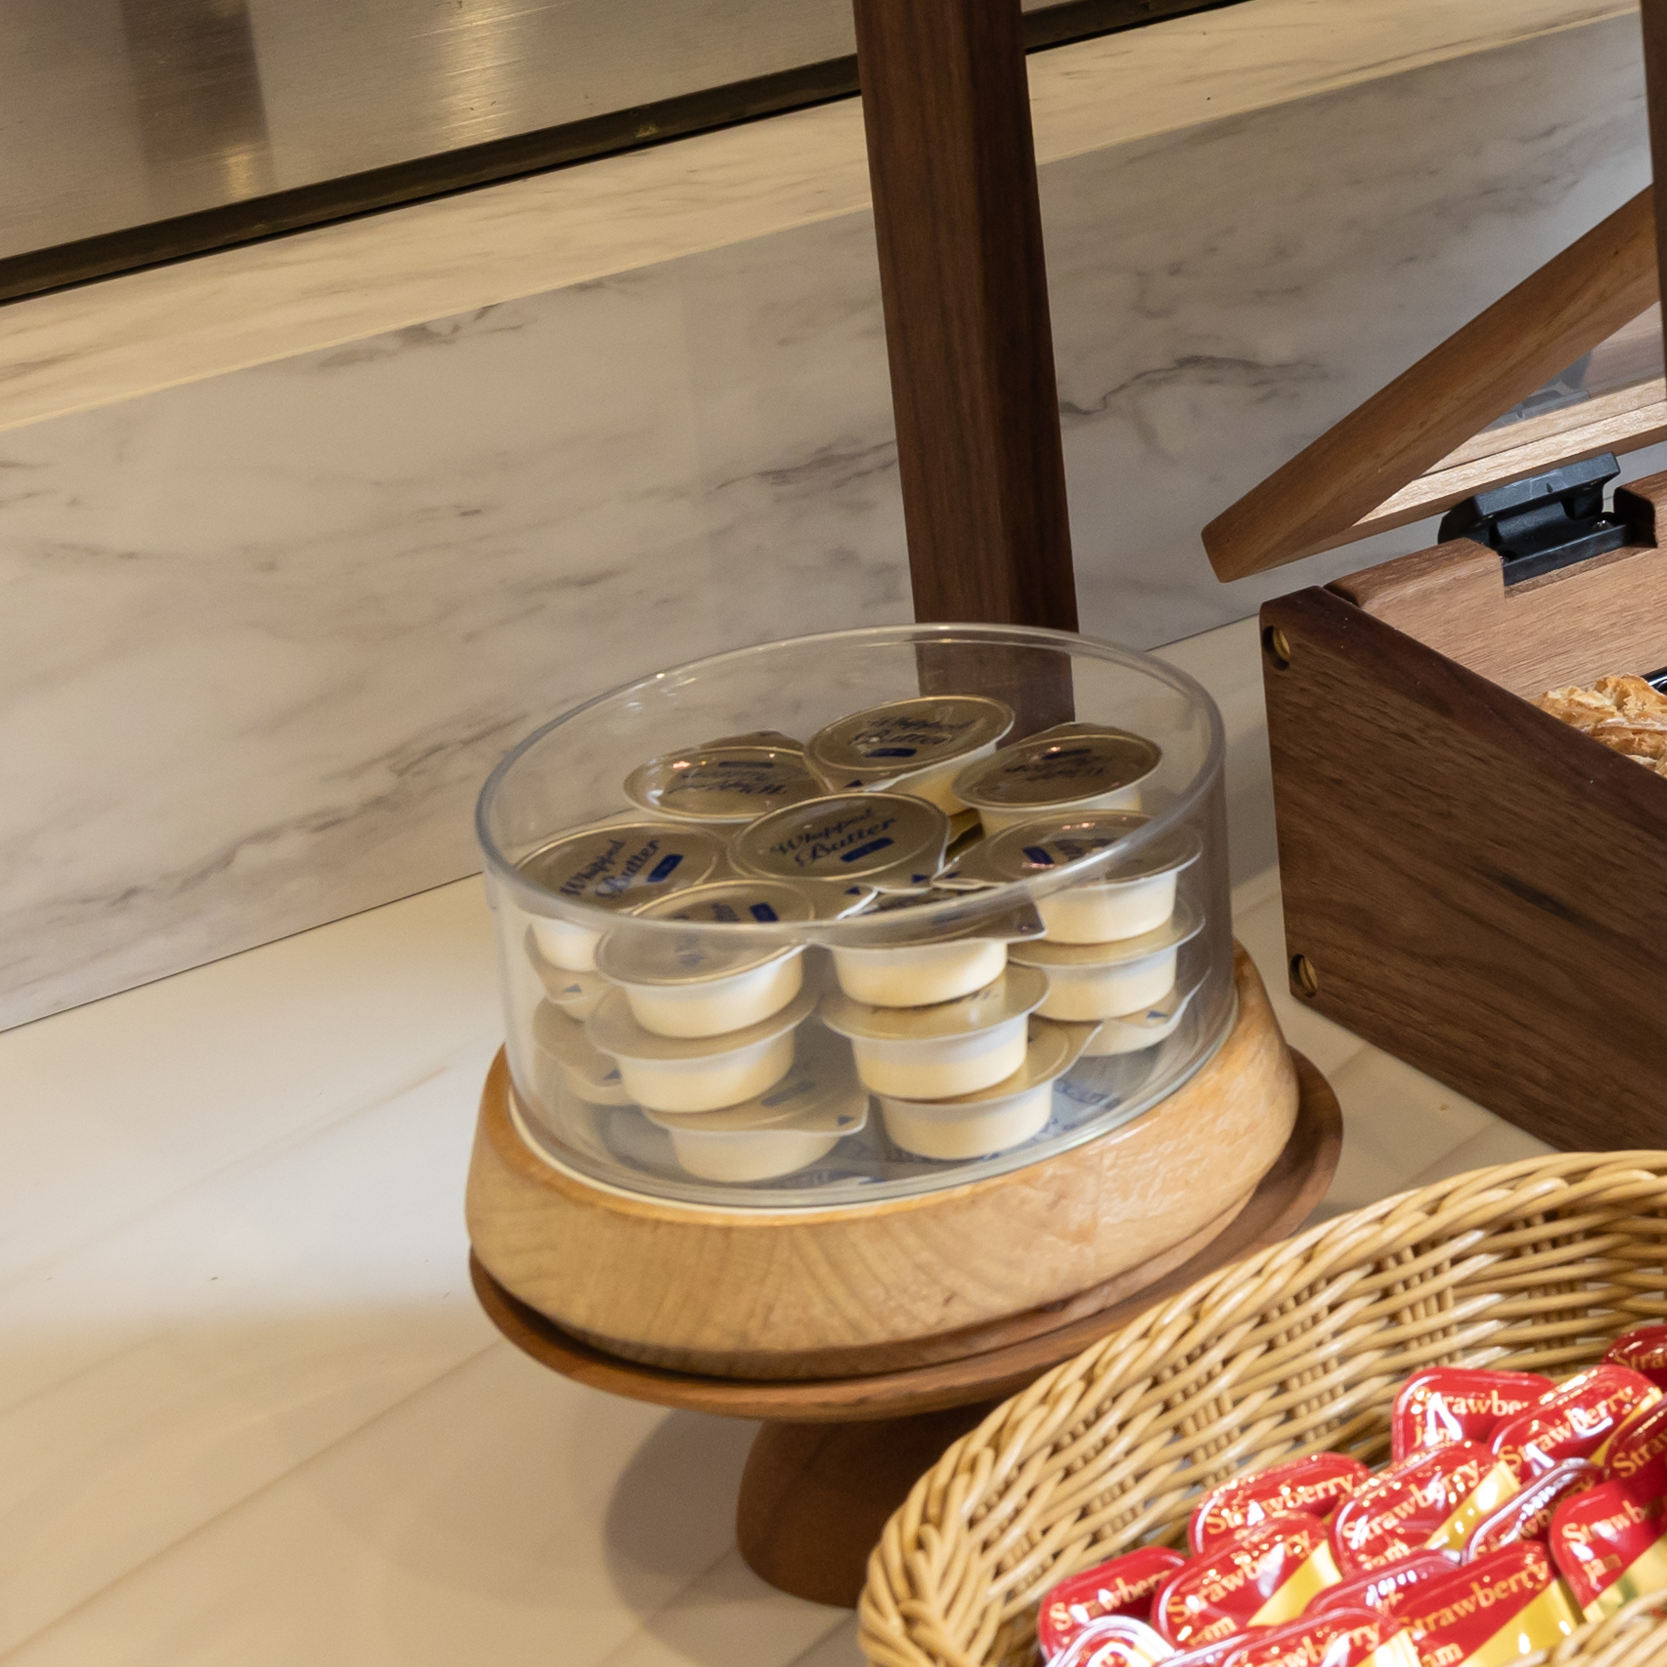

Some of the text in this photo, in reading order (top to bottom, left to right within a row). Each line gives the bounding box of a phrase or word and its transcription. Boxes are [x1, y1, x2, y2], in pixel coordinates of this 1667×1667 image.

[769, 808, 874, 855] Whipped
[794, 817, 896, 868] Butter
[1205, 1474, 1354, 1535] Strwberry
